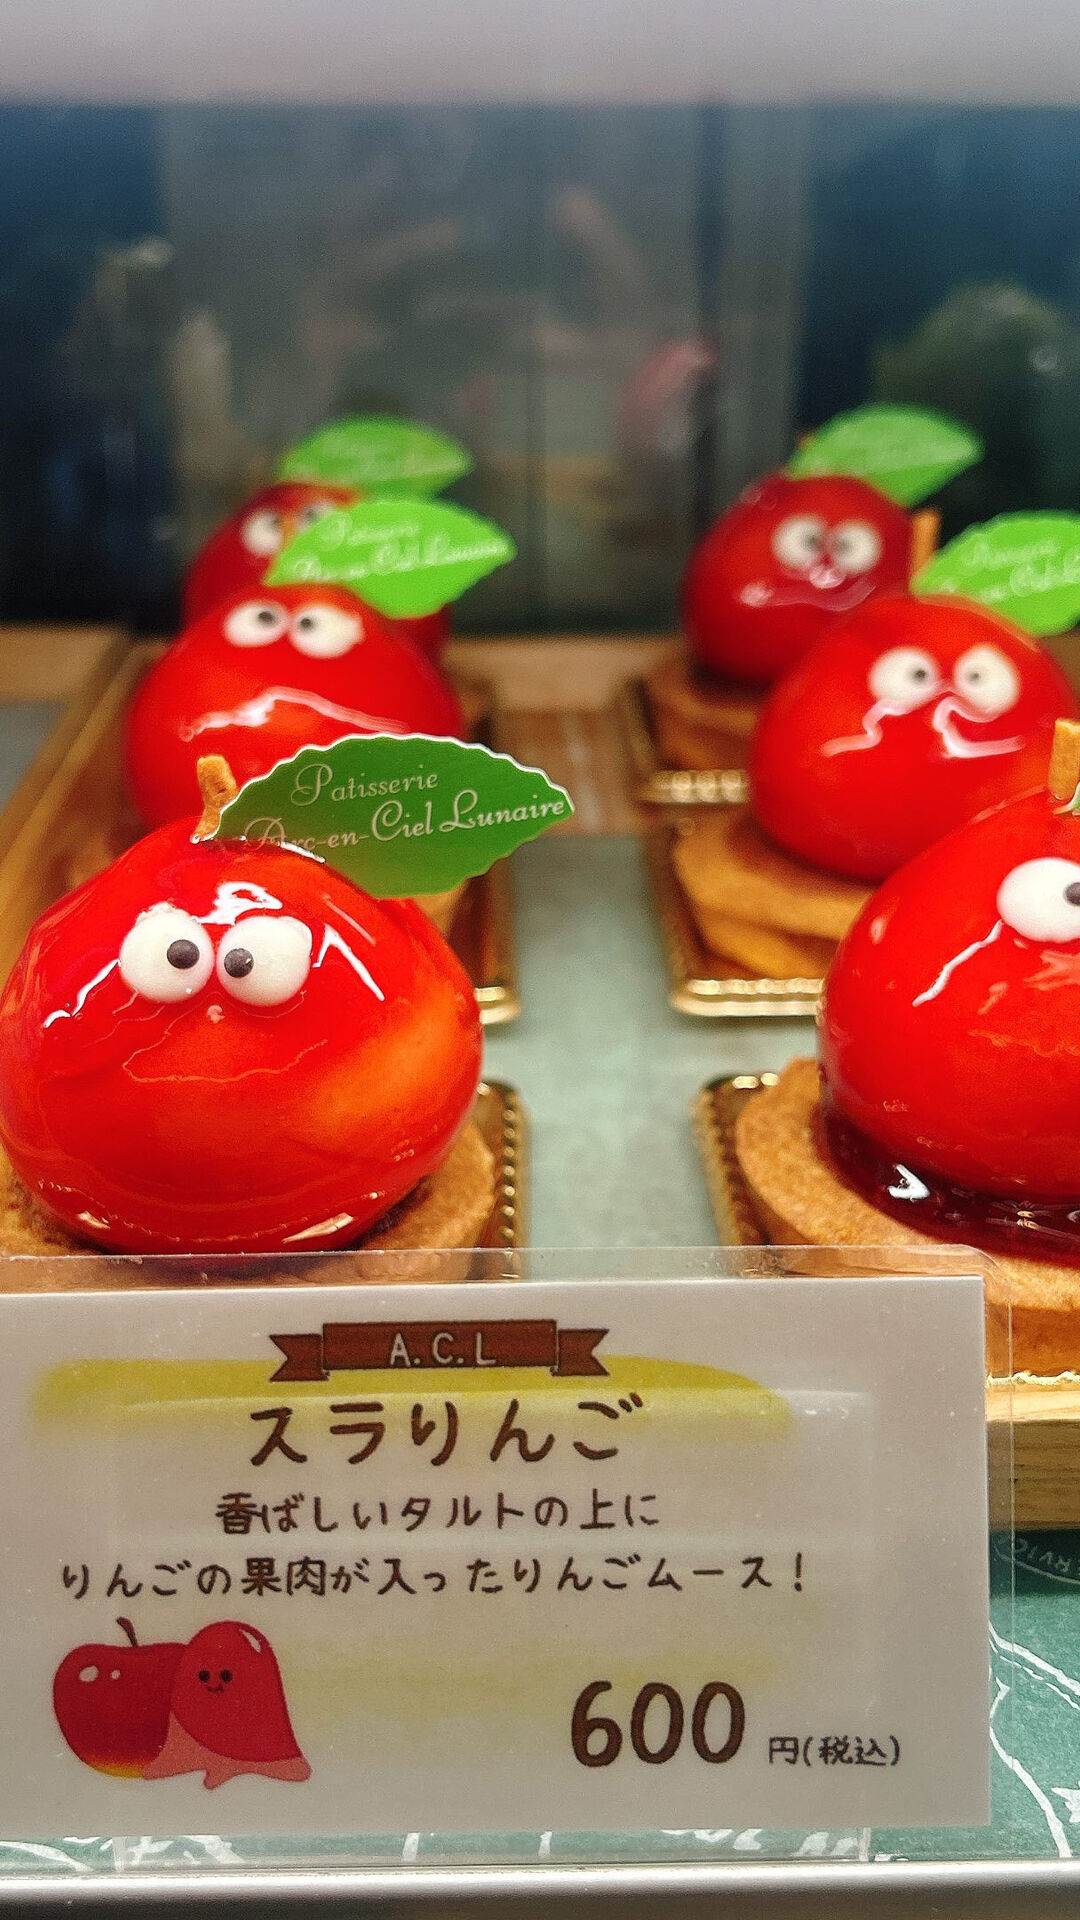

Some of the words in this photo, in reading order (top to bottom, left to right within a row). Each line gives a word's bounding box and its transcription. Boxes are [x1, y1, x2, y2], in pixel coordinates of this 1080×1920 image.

[290, 763, 438, 806] Patisserie
[438, 789, 565, 832] Lunaire
[390, 1332, 497, 1367] A.C.L
[249, 1393, 644, 1466] スラりんご
[215, 1488, 661, 1535] 香ばしいタルトの上に
[570, 1681, 746, 1768] 600
